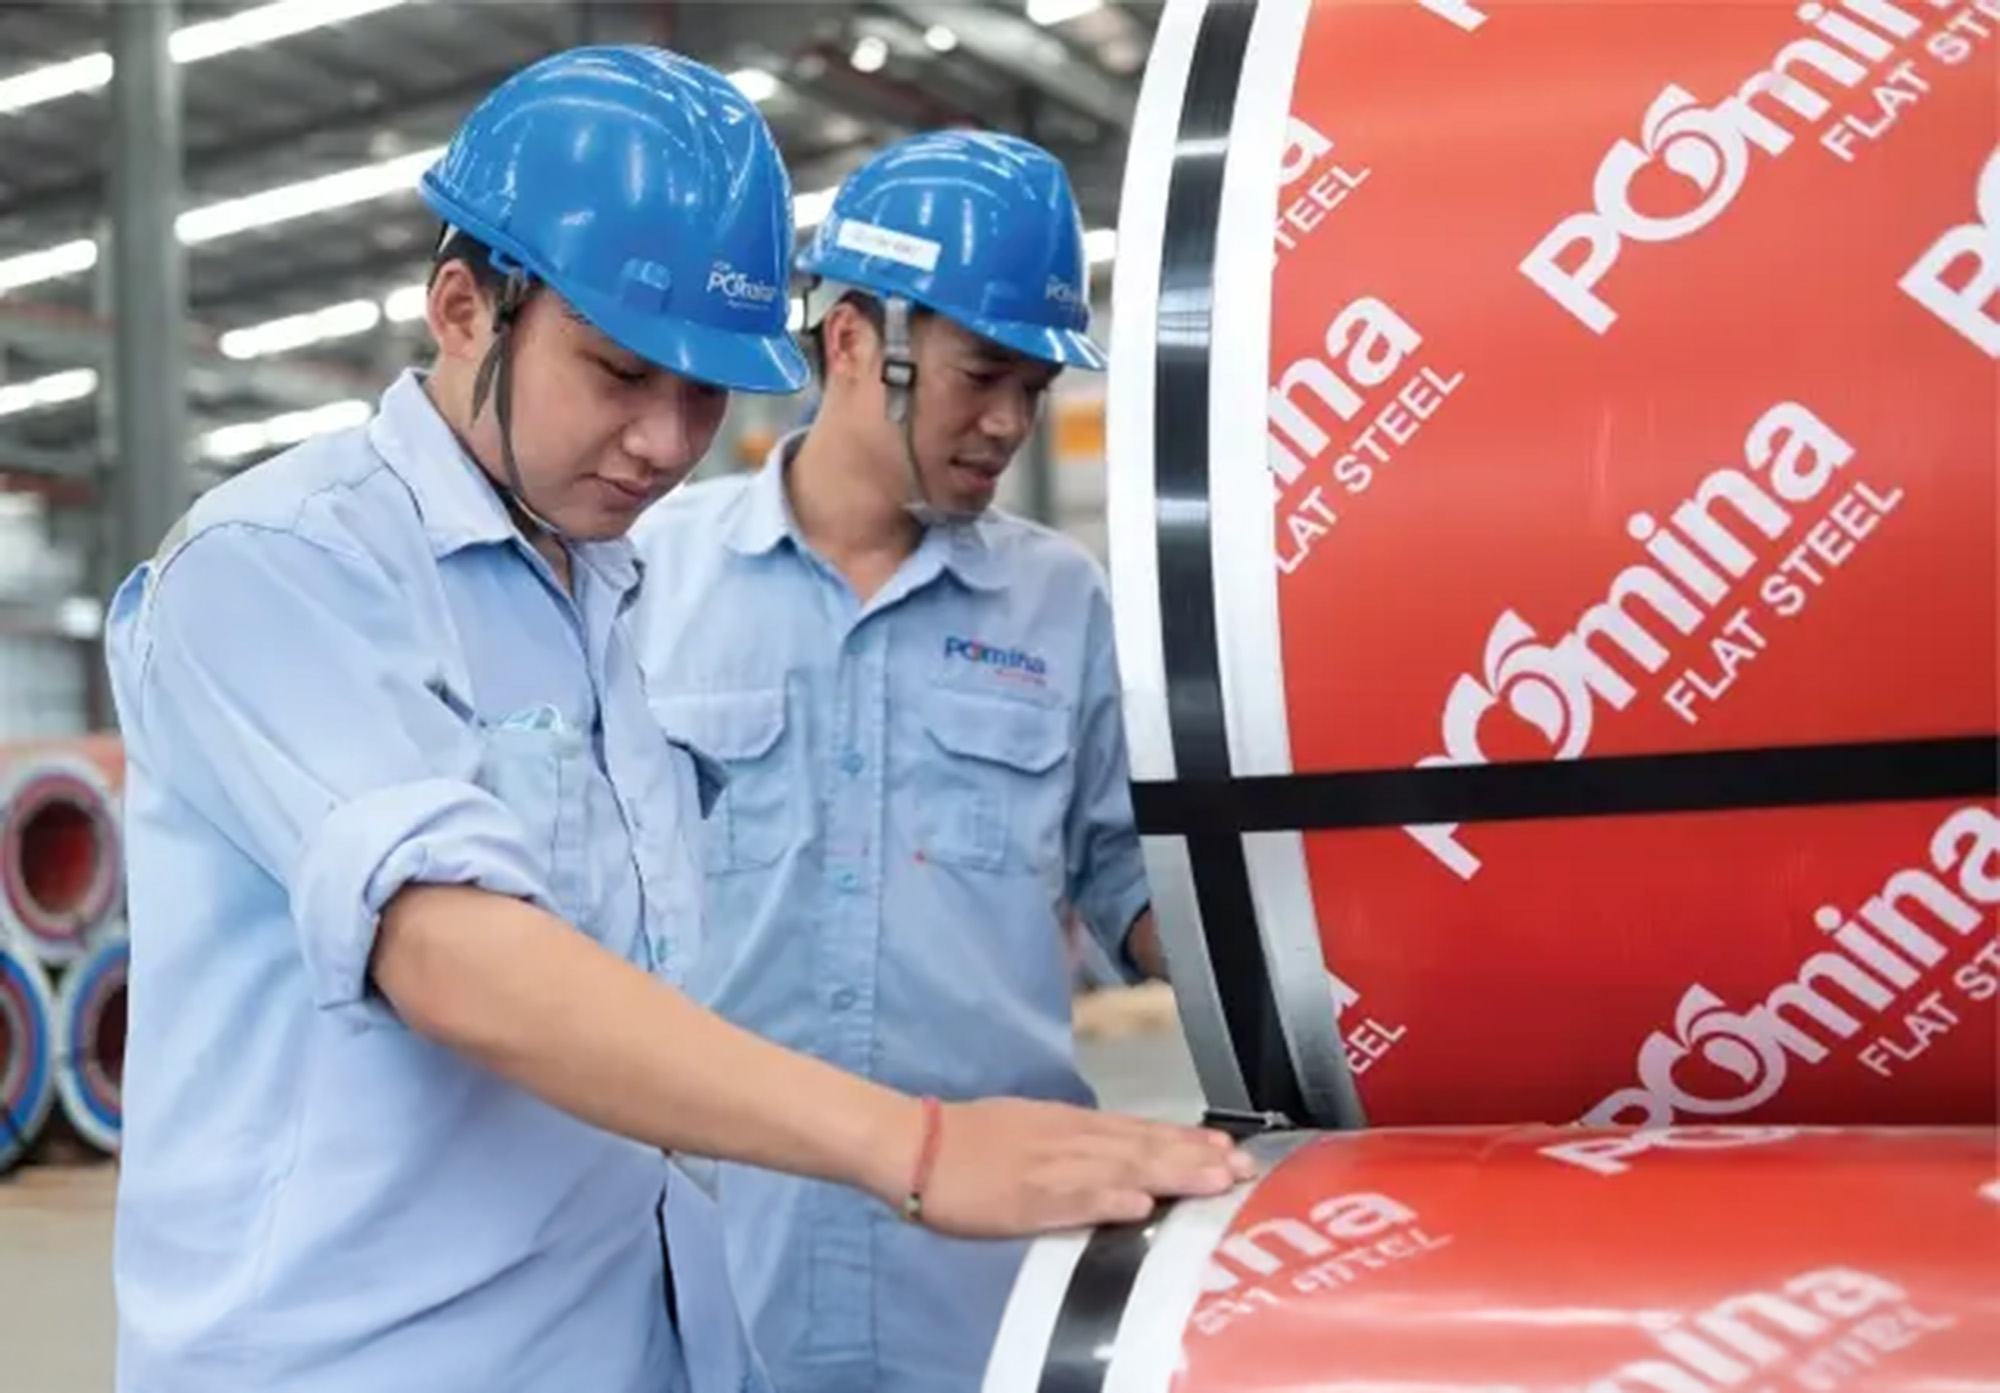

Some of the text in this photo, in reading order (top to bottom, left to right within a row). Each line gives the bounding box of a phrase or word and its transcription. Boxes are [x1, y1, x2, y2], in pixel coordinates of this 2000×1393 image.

[1819, 59, 1930, 163] FLAT
[1272, 164, 1372, 268] TEEL
[1518, 0, 1956, 335] POmi
[1275, 485, 1337, 574] LAT
[1333, 366, 1465, 494] STEEL
[1664, 481, 1904, 723] FLAT STEEL
[1341, 1018, 1407, 1075] EEL
[1857, 990, 1959, 1077] FLAT
